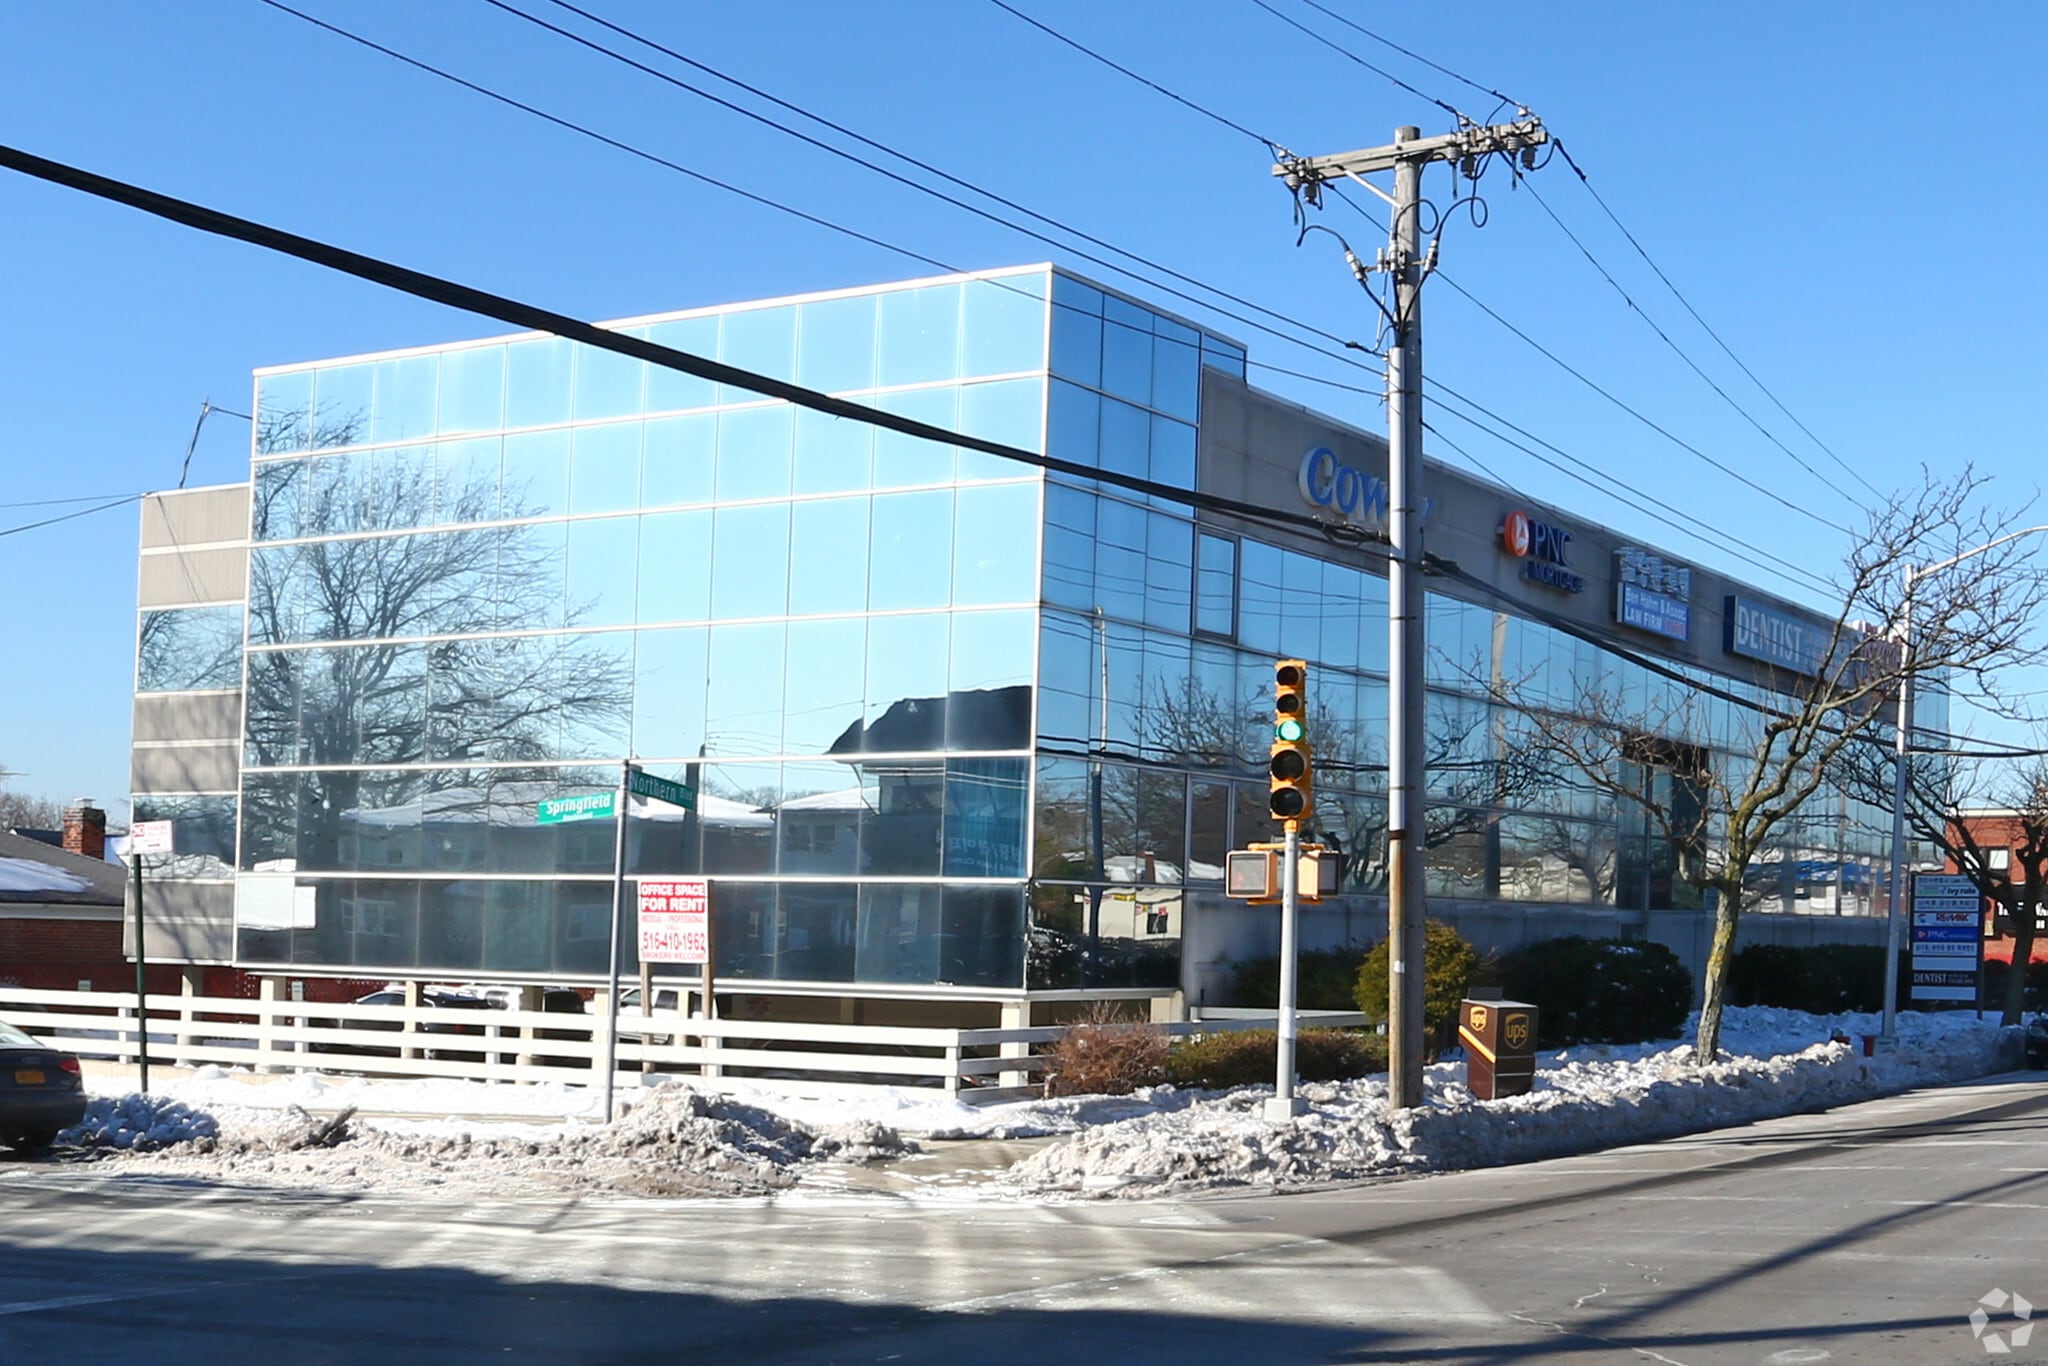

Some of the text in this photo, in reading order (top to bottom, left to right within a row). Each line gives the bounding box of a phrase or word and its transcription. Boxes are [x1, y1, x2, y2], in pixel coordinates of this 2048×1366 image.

[1533, 520, 1574, 568] PNC
[1737, 604, 1803, 663] DENTIST
[630, 771, 676, 802] Northern
[547, 793, 612, 816] Springfield
[641, 883, 705, 896] OFFICE SPACE
[641, 897, 705, 911] FOR RENT
[643, 931, 705, 951] 516-410-1962
[1927, 930, 1949, 938] PNC
[1913, 973, 1947, 984] DENTIST
[1507, 1024, 1528, 1043] ups
